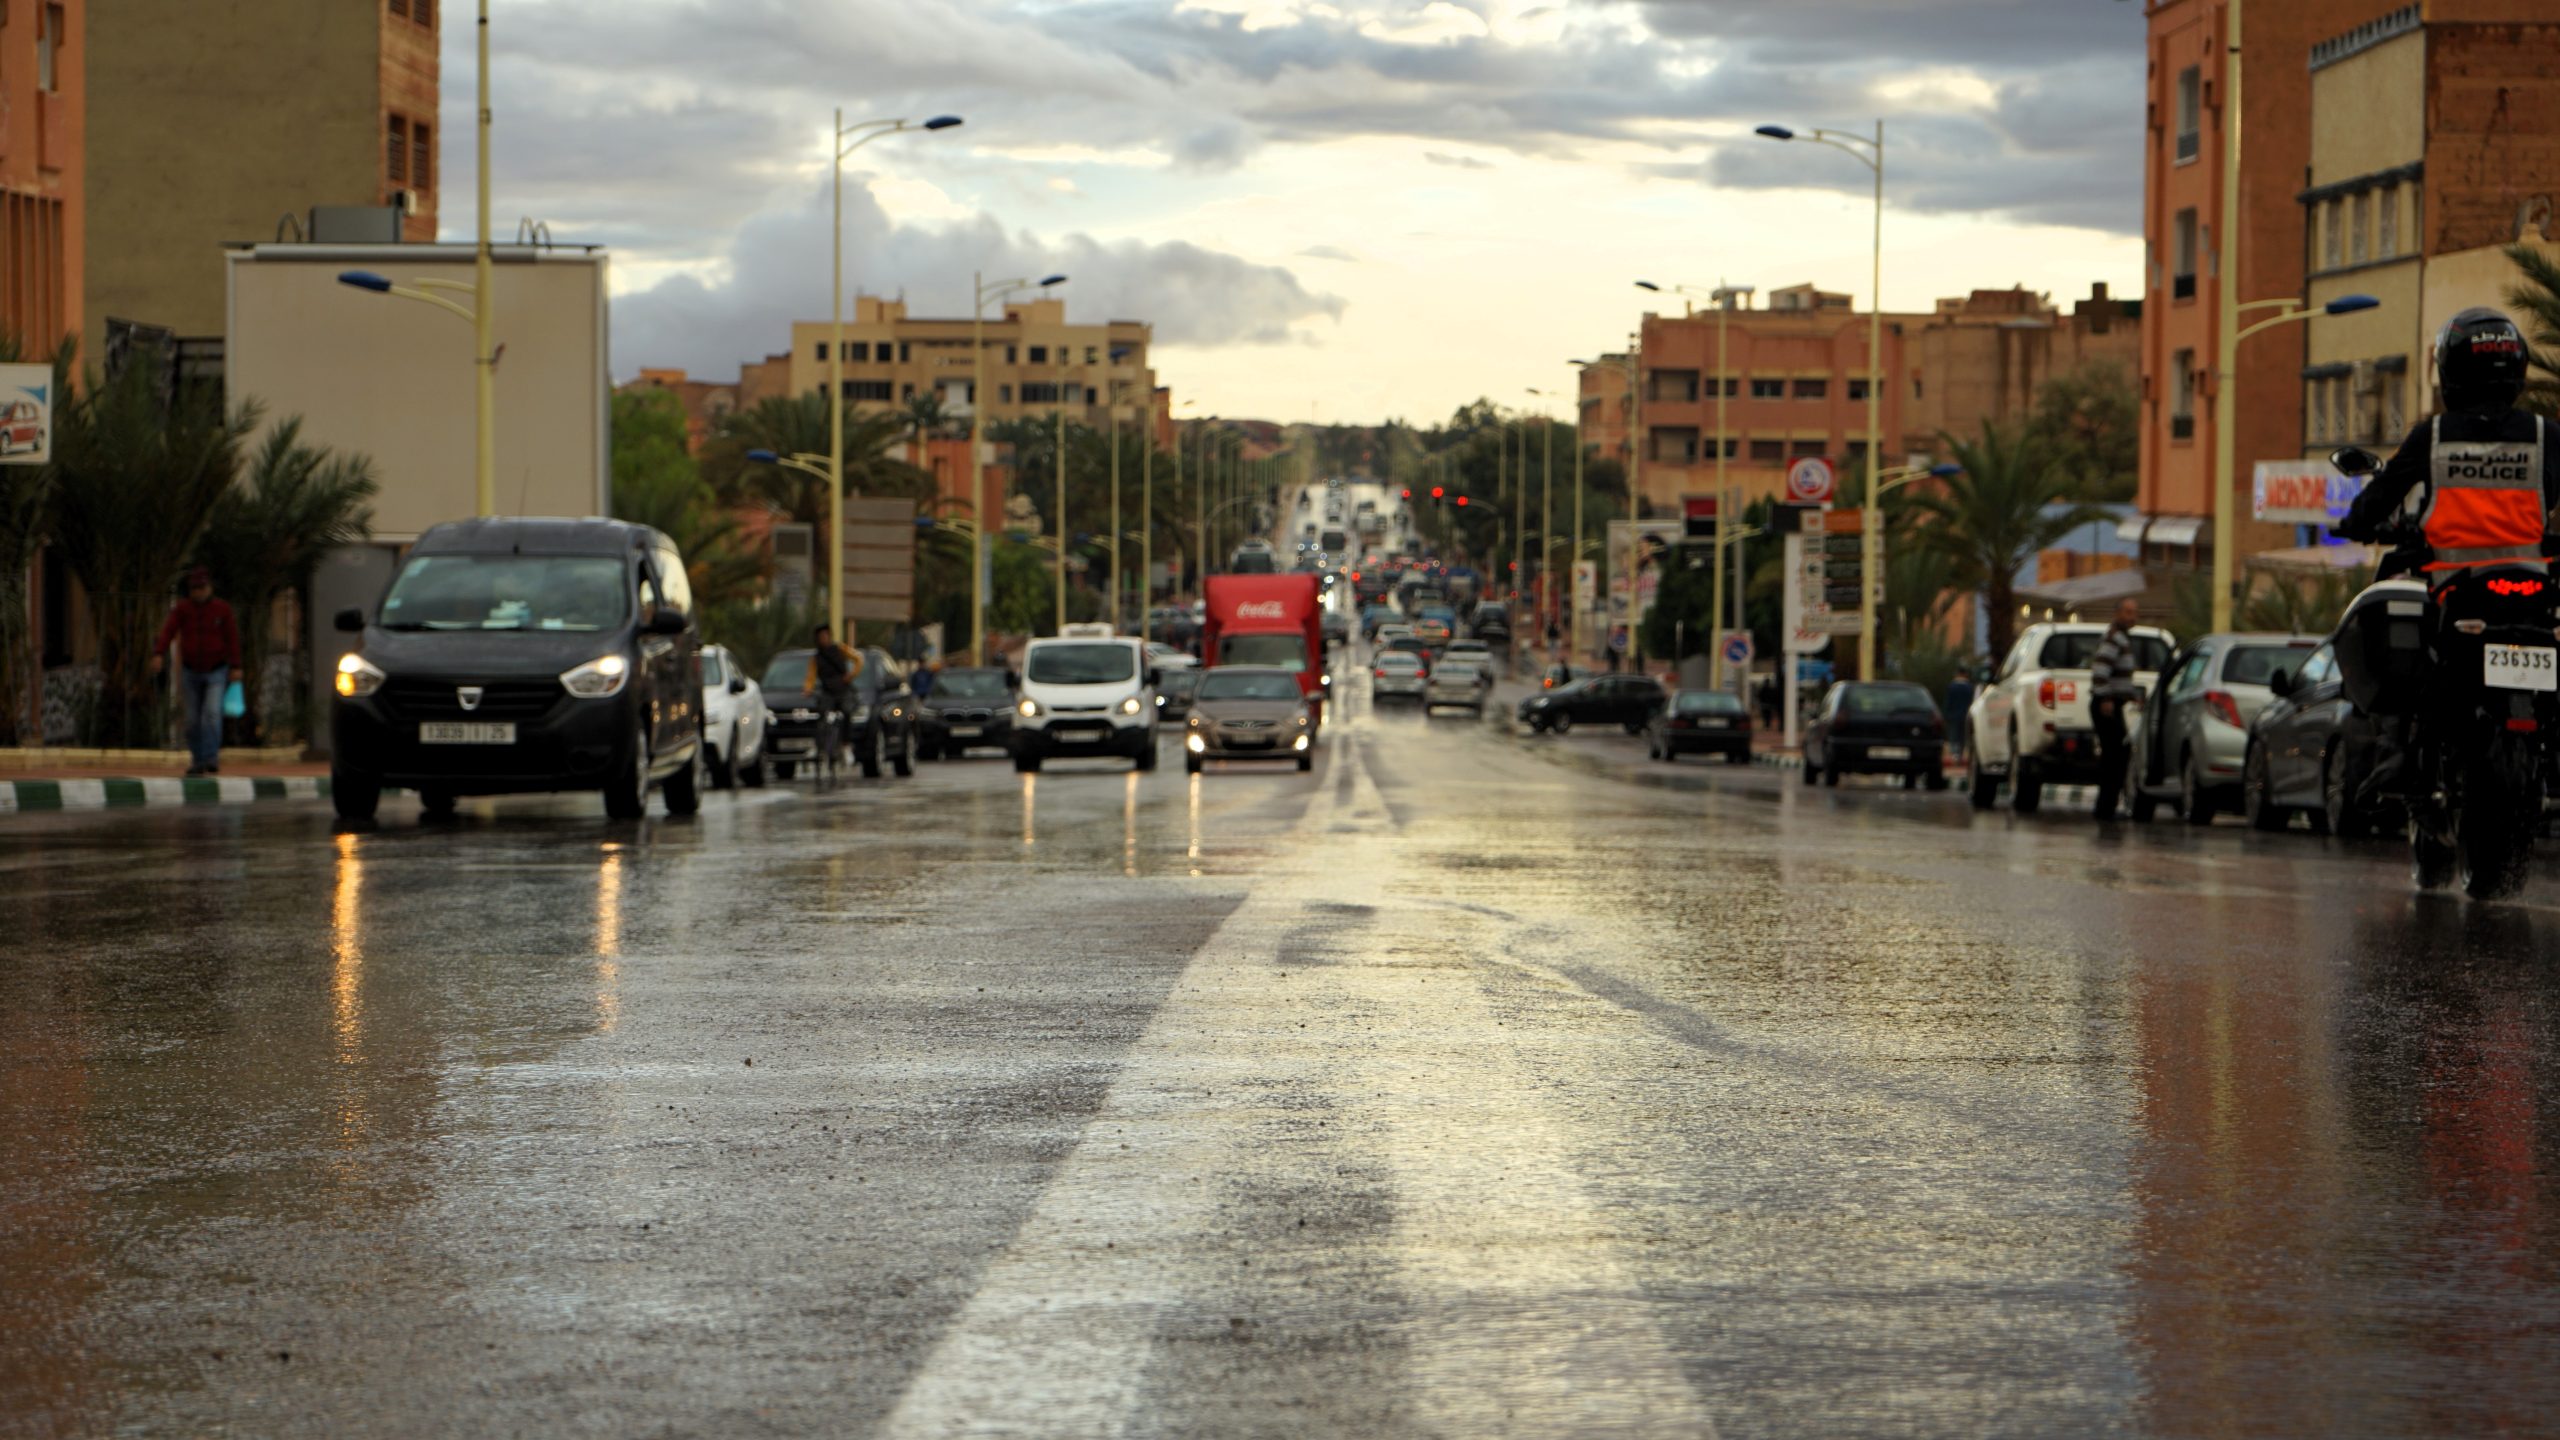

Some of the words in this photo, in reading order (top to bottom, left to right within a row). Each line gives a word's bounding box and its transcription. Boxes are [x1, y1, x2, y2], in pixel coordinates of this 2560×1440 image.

[2449, 452, 2528, 466] الشرطة
[2448, 465, 2528, 480] POLICE
[2489, 650, 2552, 669] 236335
